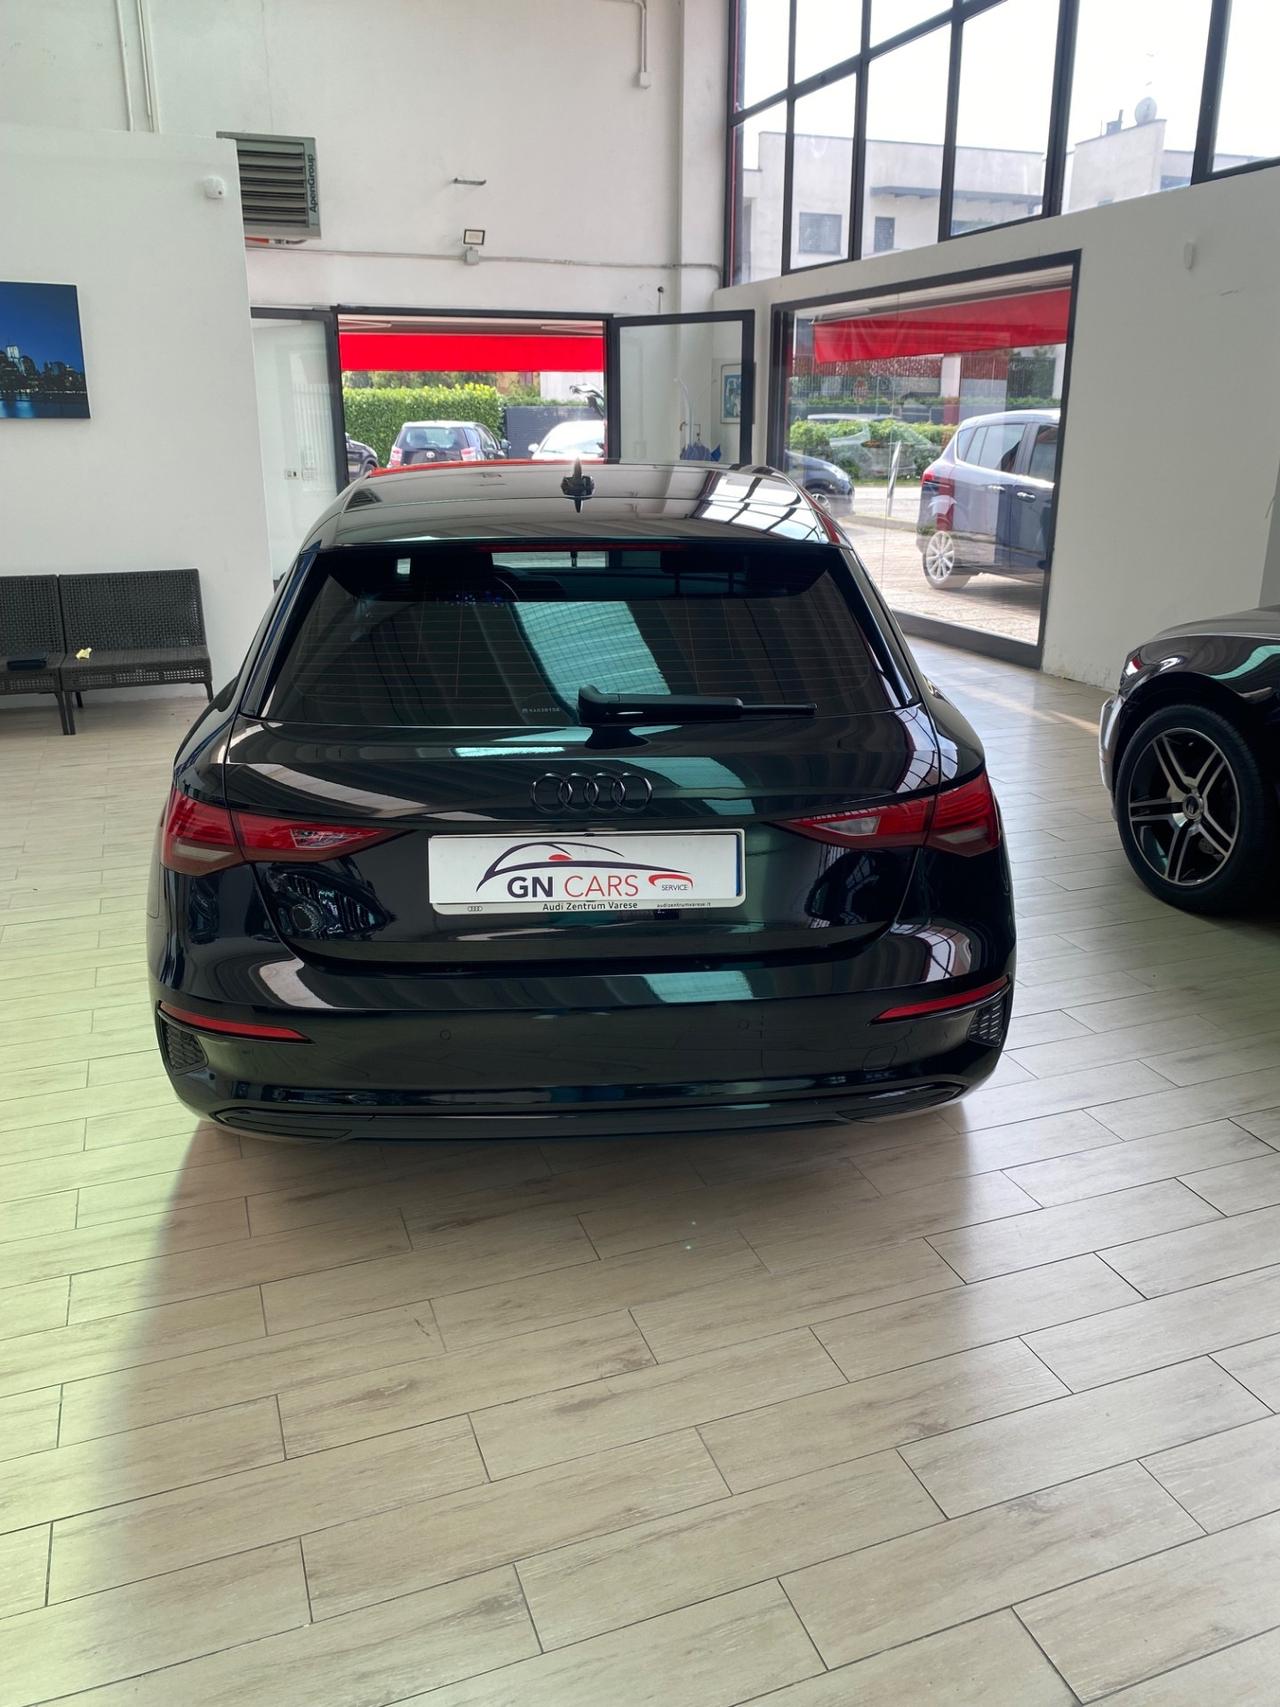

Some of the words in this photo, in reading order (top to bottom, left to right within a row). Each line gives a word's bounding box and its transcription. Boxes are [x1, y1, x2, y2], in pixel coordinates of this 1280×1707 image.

[307, 154, 318, 213] ApenGroup
[507, 876, 553, 898] GN
[564, 874, 639, 898] CARS
[661, 883, 688, 891] SERVICE
[542, 902, 564, 911] Audi
[566, 902, 606, 911] Zentrum
[608, 901, 638, 909] Varese
